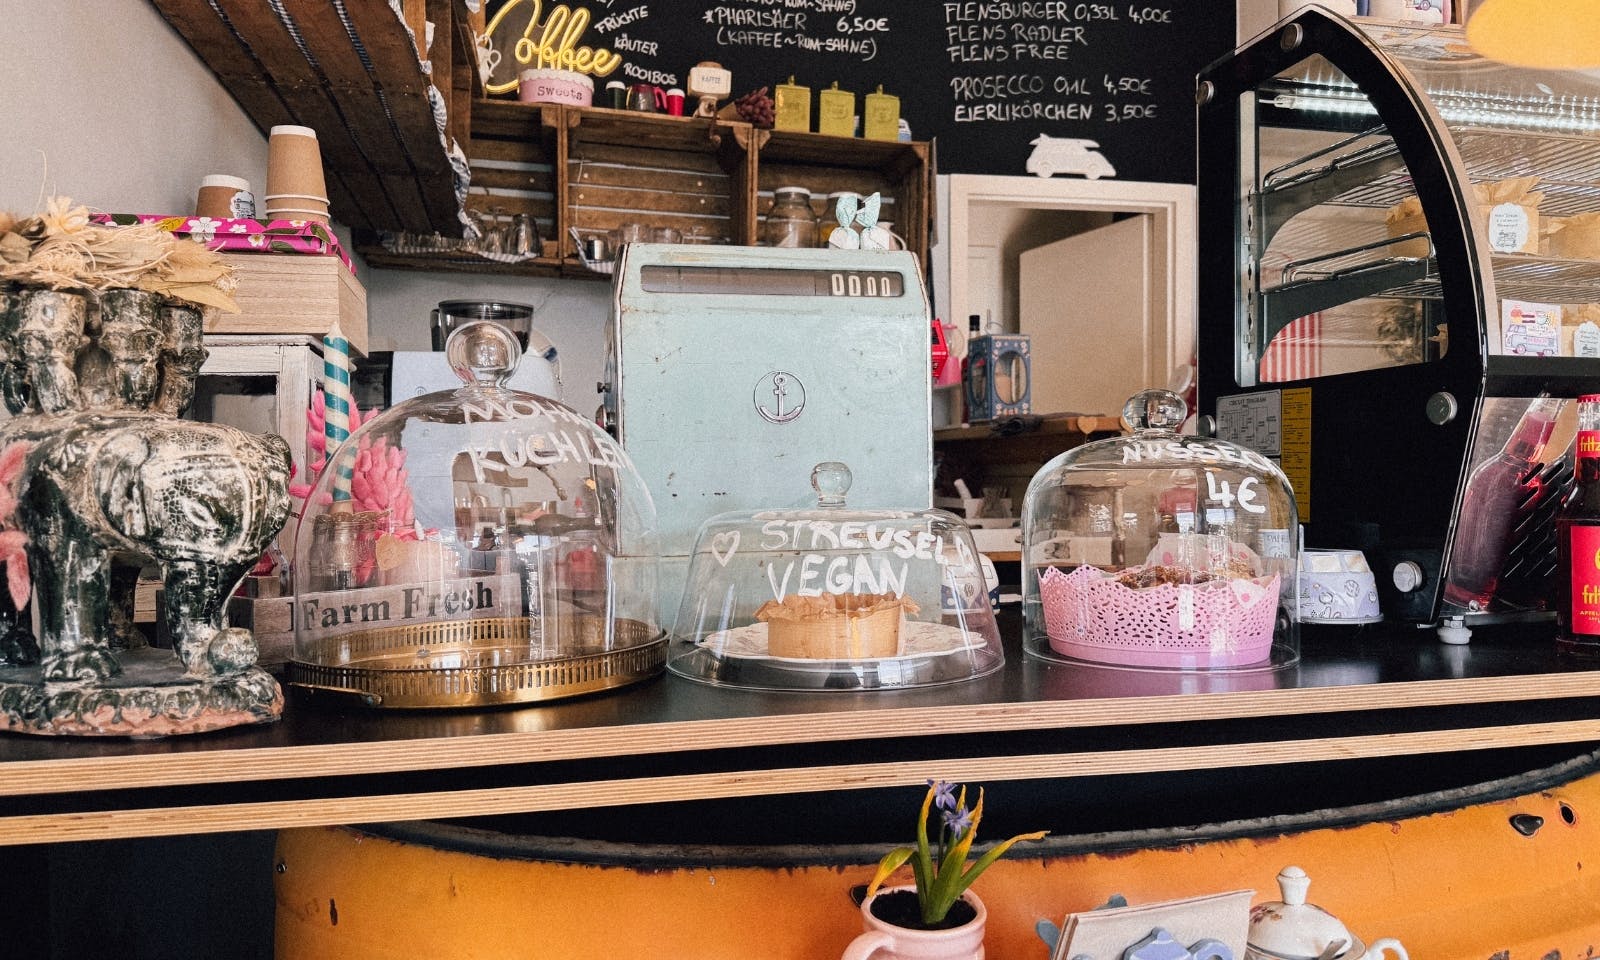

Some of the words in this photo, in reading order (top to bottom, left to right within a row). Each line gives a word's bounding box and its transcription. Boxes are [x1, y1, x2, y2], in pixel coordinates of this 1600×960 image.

[594, 5, 648, 34] FRÜCHTE
[714, 7, 807, 30] PHARISÄER
[836, 16, 890, 35] 6,50€
[944, 1, 1070, 23] FLENSBURGER
[1074, 4, 1119, 21] 0,33L
[1128, 4, 1172, 24] 4,00€
[614, 33, 658, 56] KÄUTER
[946, 24, 1006, 44] FLENS
[1011, 23, 1088, 45] RADLER
[484, 0, 622, 94] Coffee
[946, 45, 1009, 62] FLENS
[1011, 44, 1069, 60] FREE
[623, 62, 678, 85] ROOIBOS
[537, 86, 582, 101] Sweets
[950, 75, 1044, 100] PROSECCO
[1103, 74, 1152, 96] 4,50€
[954, 100, 1093, 122] EIERLIKÖRCHEN
[1105, 104, 1158, 123] 3,50€
[1205, 471, 1266, 514] 4€
[767, 554, 908, 604] VEGAN
[302, 598, 391, 630] Farm
[401, 581, 493, 619] Fresh
